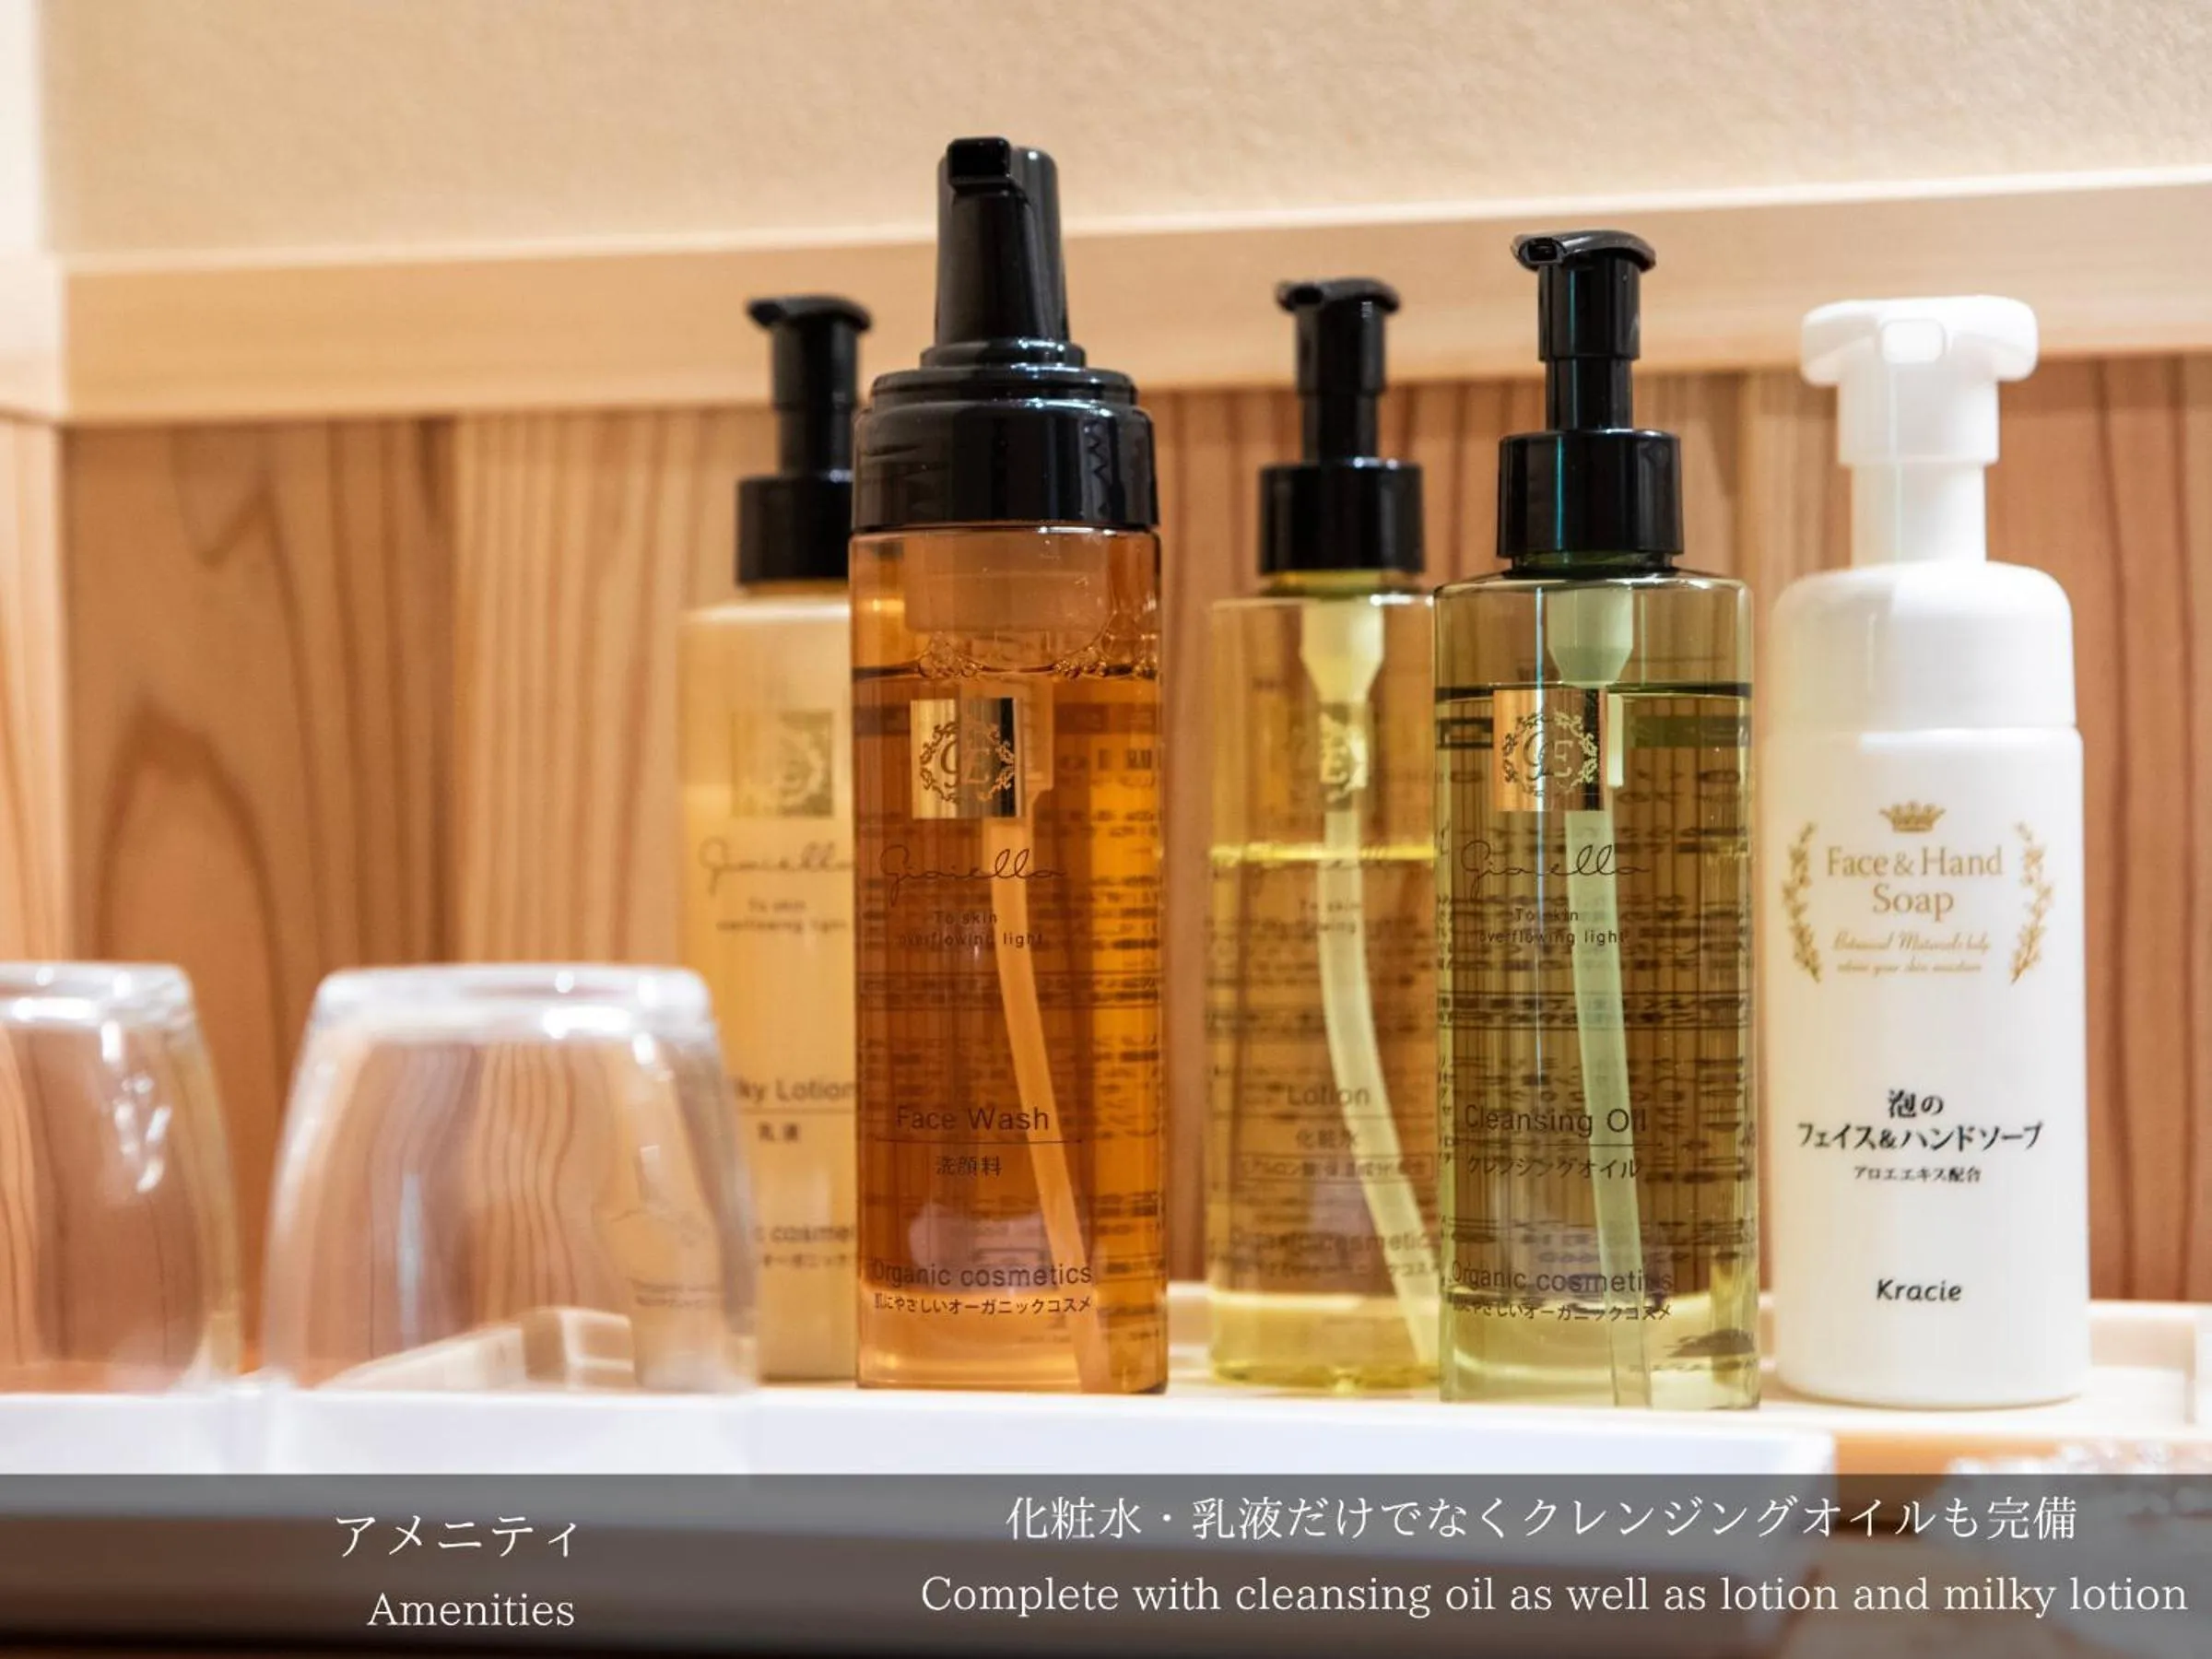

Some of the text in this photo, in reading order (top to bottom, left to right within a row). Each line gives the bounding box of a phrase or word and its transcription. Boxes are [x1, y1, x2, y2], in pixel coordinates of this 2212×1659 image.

[1827, 846, 1889, 877] Face
[1921, 845, 2004, 877] Hand
[1873, 883, 1955, 922] Soap
[962, 910, 998, 925] skin
[1514, 908, 1535, 922] To
[1003, 931, 1043, 947] light
[1584, 928, 1625, 947] light
[1288, 1083, 1371, 1106] Lotion
[1888, 1088, 1945, 1119] 泡の
[896, 1106, 1050, 1131] Face Wash
[1465, 1104, 1647, 1138] Cleansing Oil
[936, 1156, 1003, 1177] 洗顔料
[1854, 1165, 1982, 1184] アロエエキス配合
[873, 1261, 1093, 1288] Organic cosmetics
[1452, 1260, 1527, 1290] Organic
[1877, 1278, 1963, 1302] Kracie
